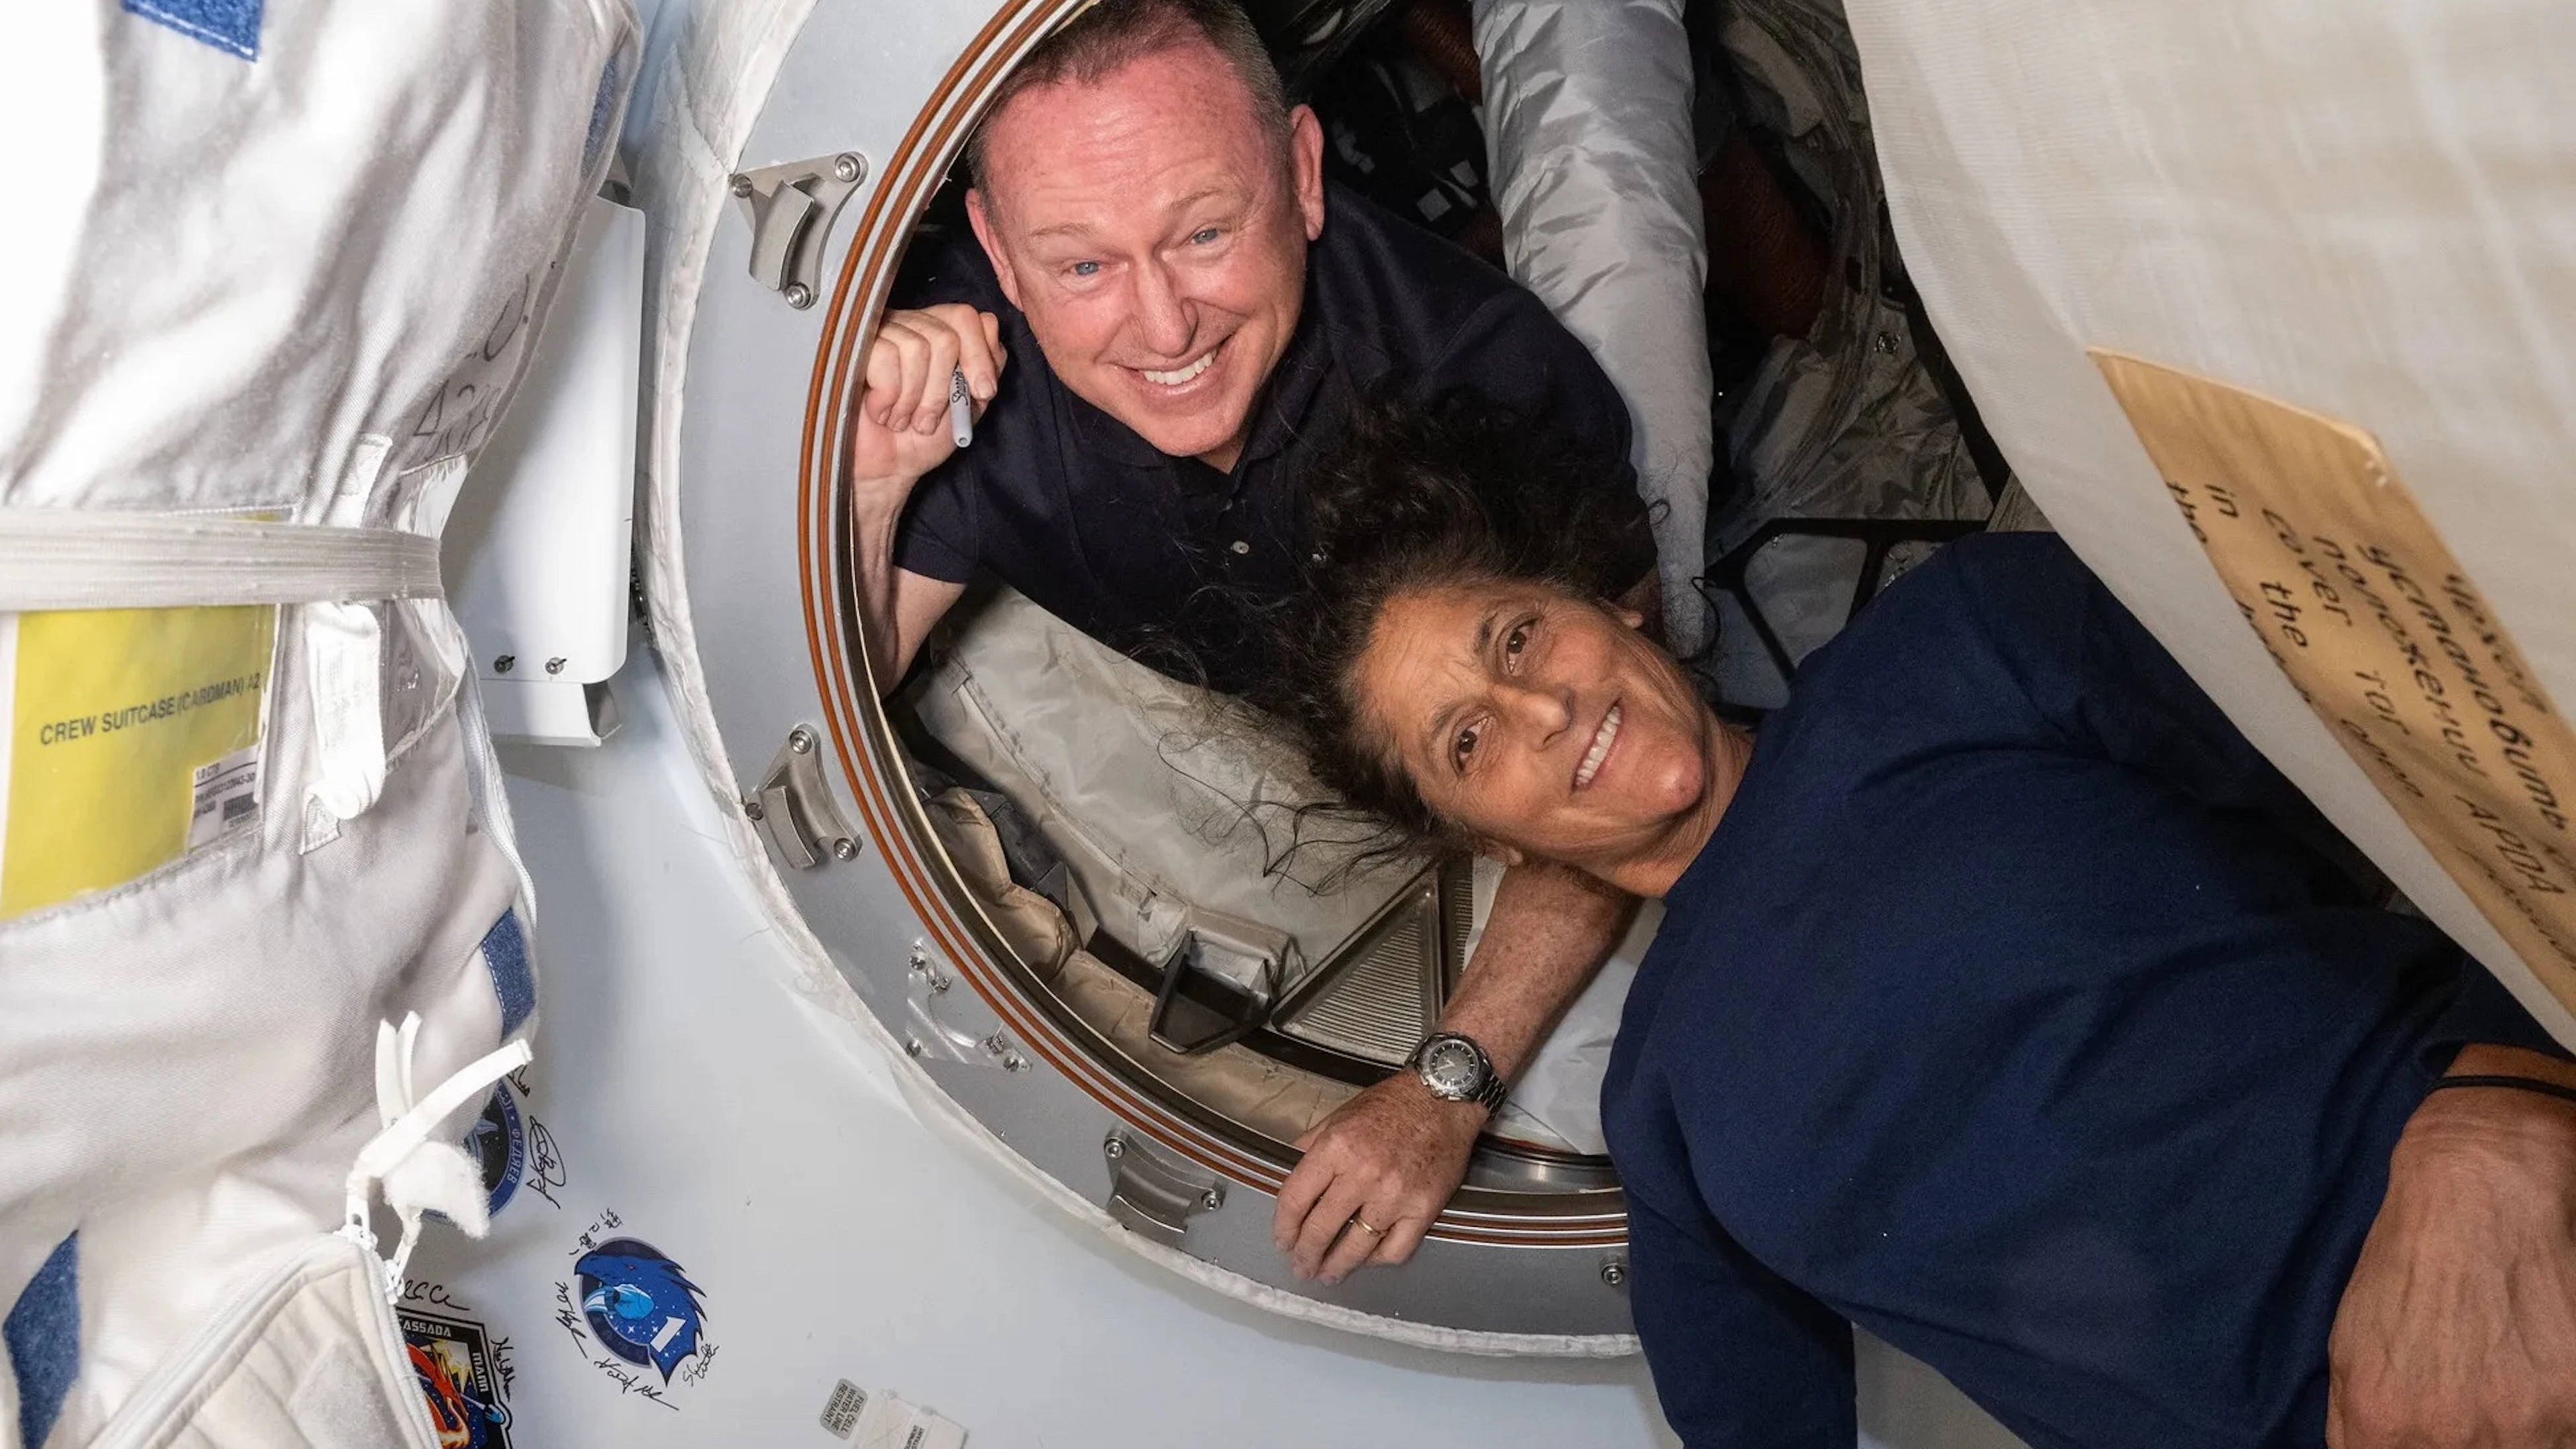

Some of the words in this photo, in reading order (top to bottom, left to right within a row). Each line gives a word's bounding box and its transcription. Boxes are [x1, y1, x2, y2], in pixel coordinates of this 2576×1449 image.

[2204, 482, 2239, 519] in
[2259, 582, 2308, 647] the
[2261, 507, 2352, 627] cover
[40, 715, 97, 746] CREW
[101, 698, 179, 733] SUITCASE
[506, 1128, 523, 1184] ФЕДЯЕВ
[823, 1383, 849, 1424] RESTRAINT
[840, 1388, 857, 1413] WATER
[850, 1395, 865, 1413] FUEL
[830, 1412, 845, 1431] LINE
[841, 1413, 856, 1432] CELL
